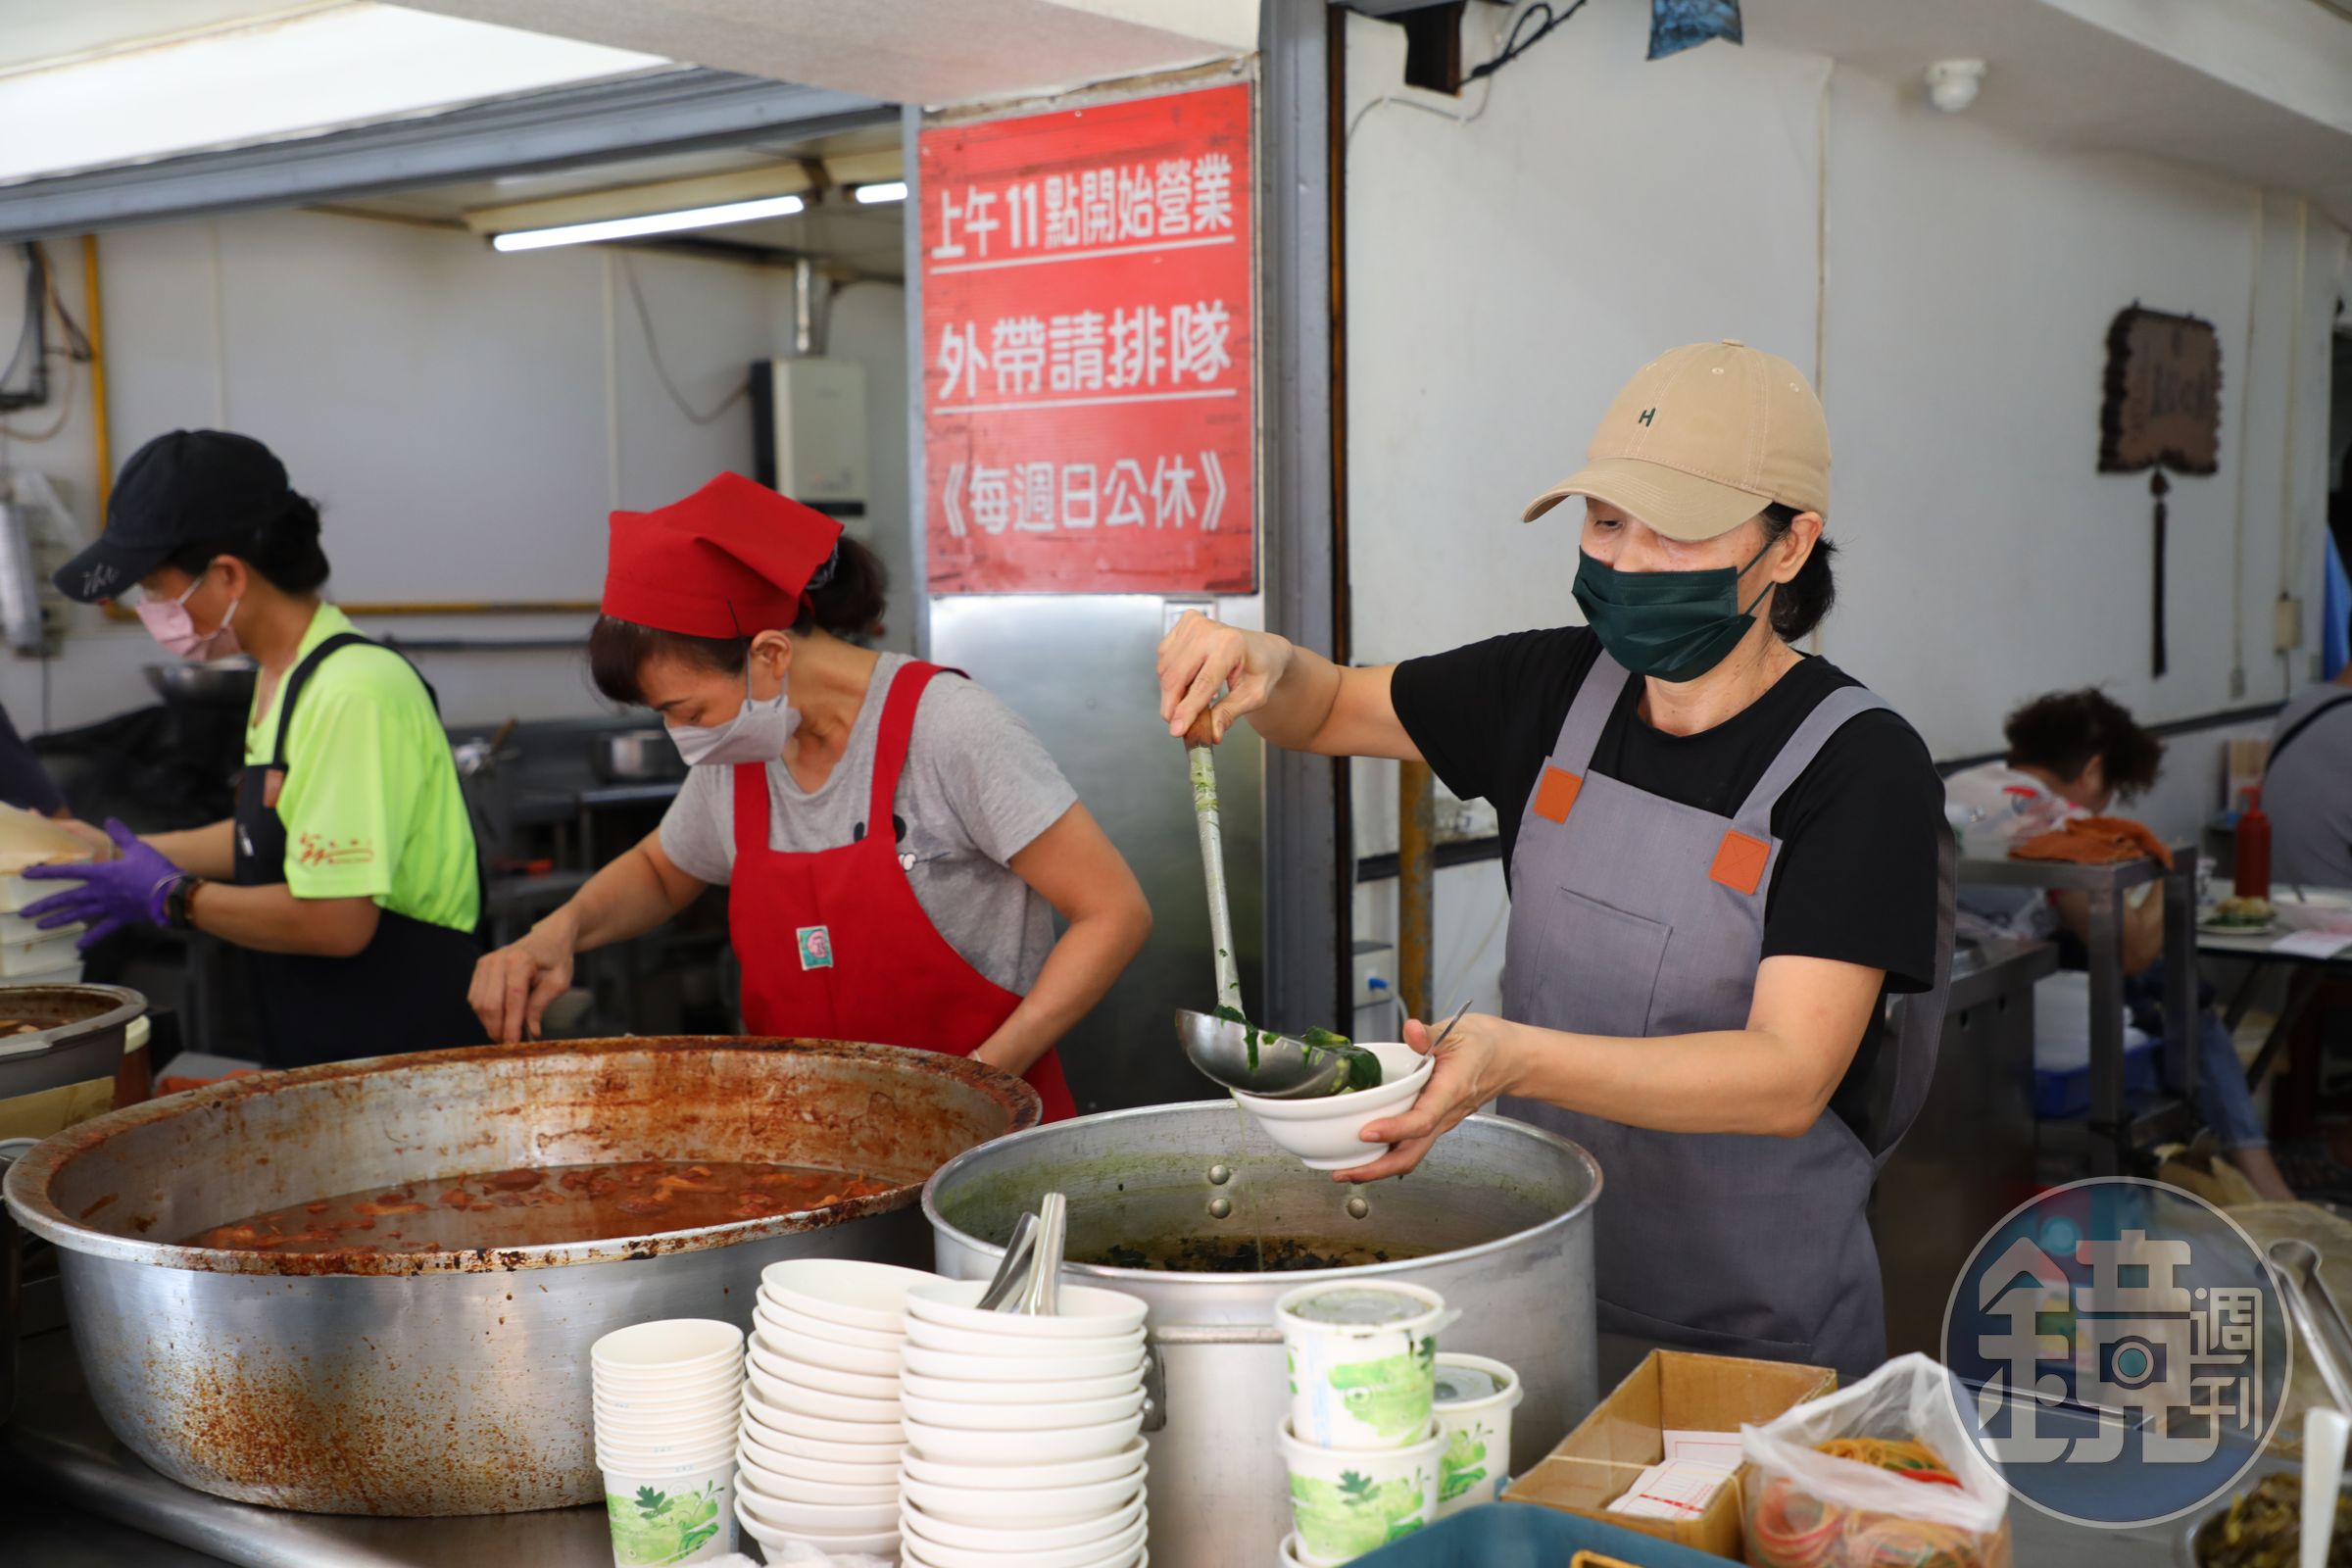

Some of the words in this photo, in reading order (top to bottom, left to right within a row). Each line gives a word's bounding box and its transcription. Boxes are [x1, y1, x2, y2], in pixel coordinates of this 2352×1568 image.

[931, 153, 1234, 259] 上午11點開始營業
[937, 299, 1231, 400] 外帶請排隊
[1638, 408, 1656, 427] H
[943, 451, 1227, 537] 《每週日公休》
